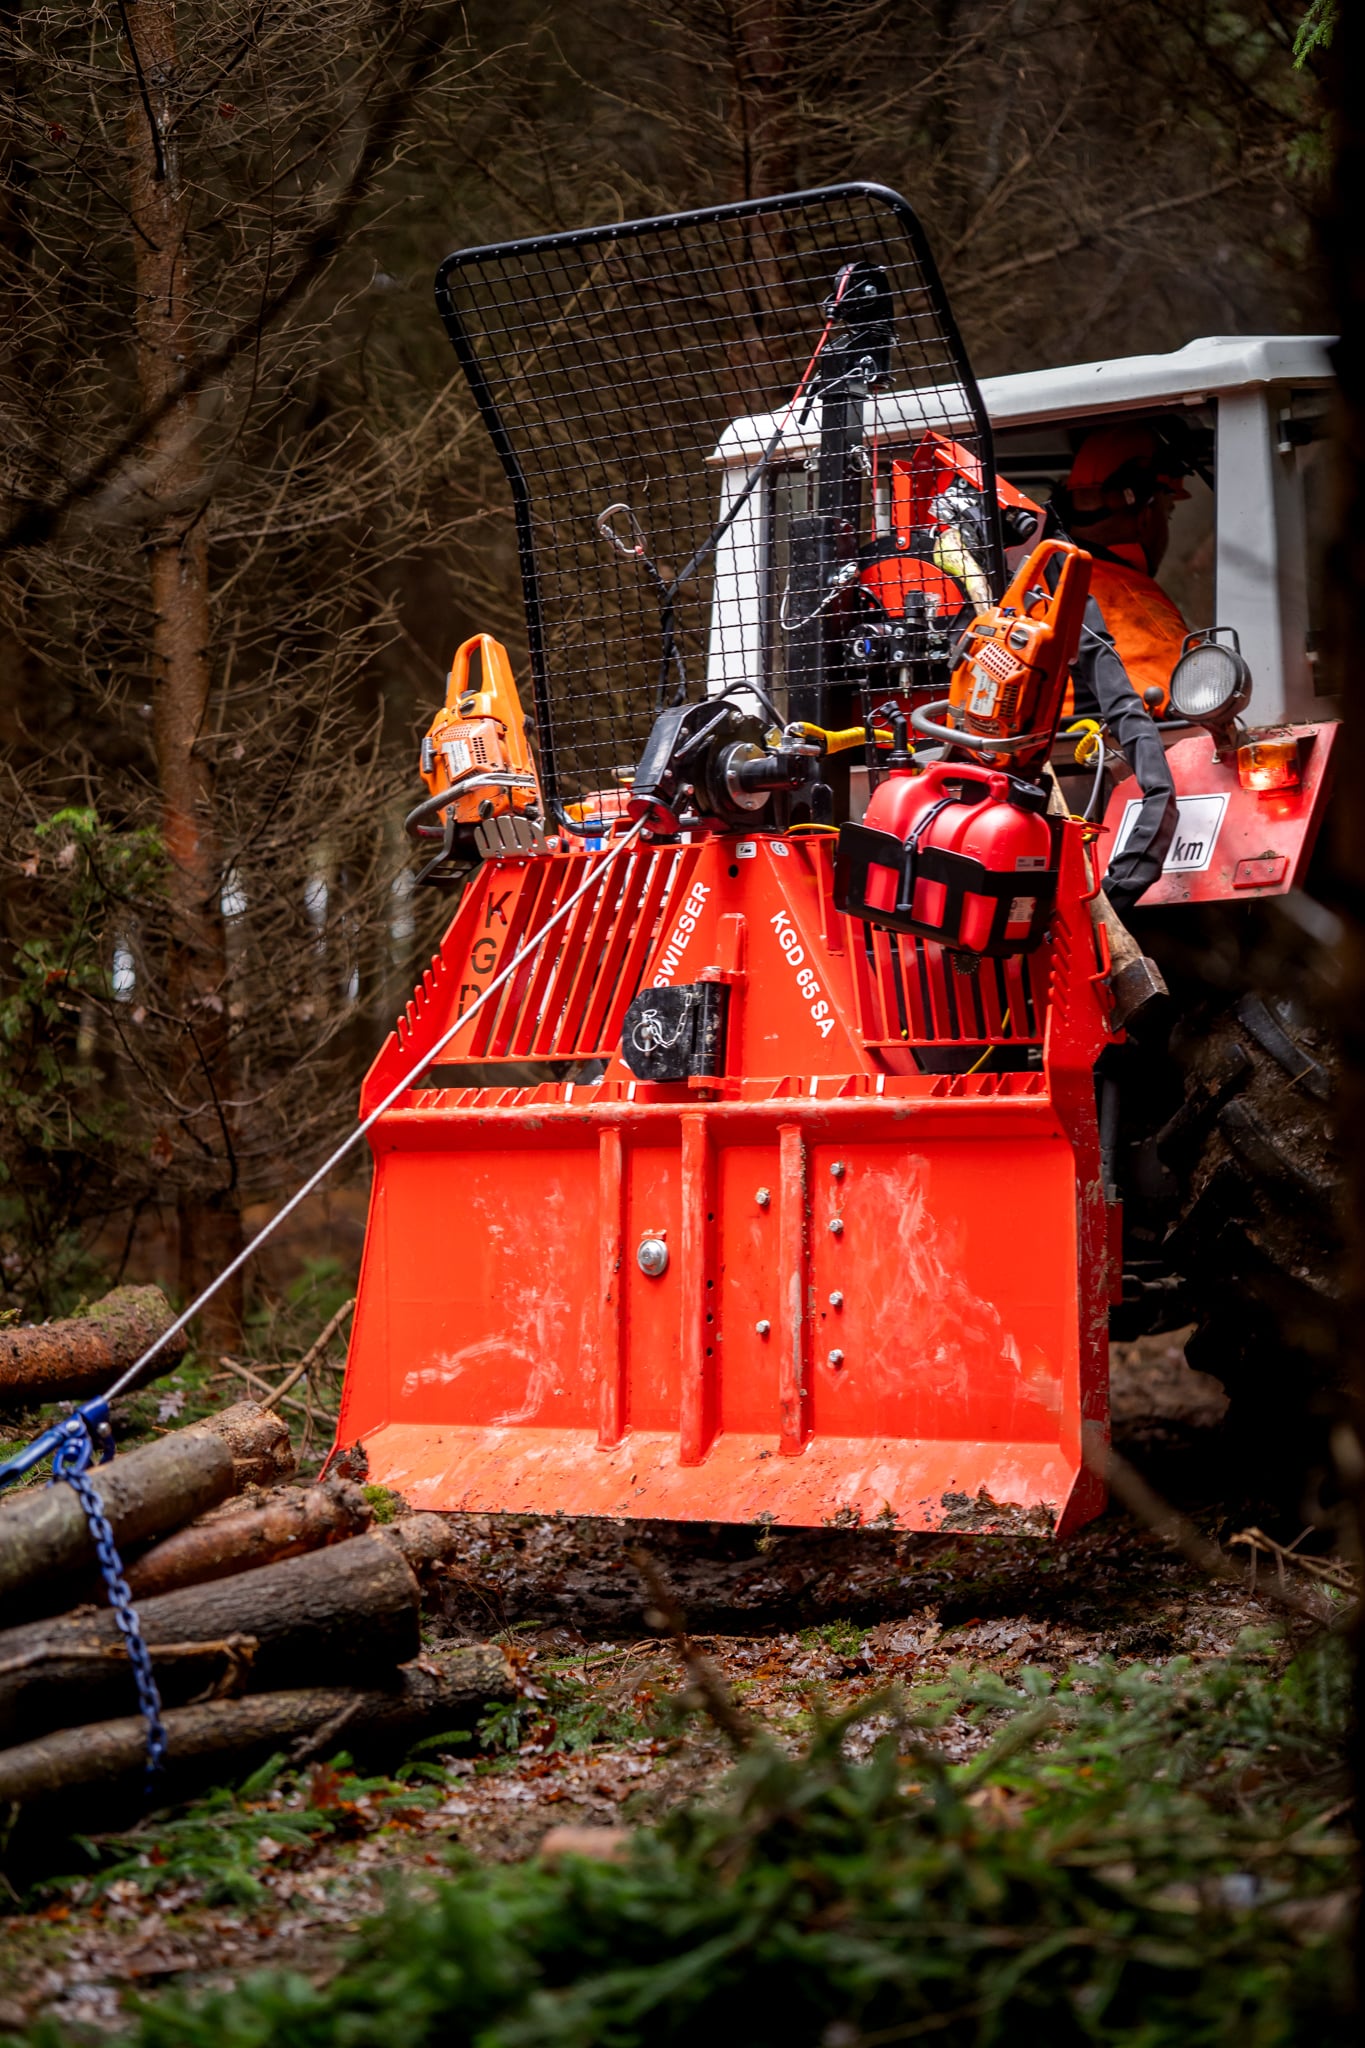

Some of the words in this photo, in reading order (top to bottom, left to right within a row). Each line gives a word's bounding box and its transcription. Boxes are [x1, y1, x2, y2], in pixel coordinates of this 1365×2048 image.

[1171, 836, 1204, 862] km
[458, 891, 513, 1021] KGD
[653, 881, 711, 989] SWIESER
[770, 910, 805, 967] KGD
[796, 968, 820, 999] 65
[810, 1000, 835, 1038] SA
